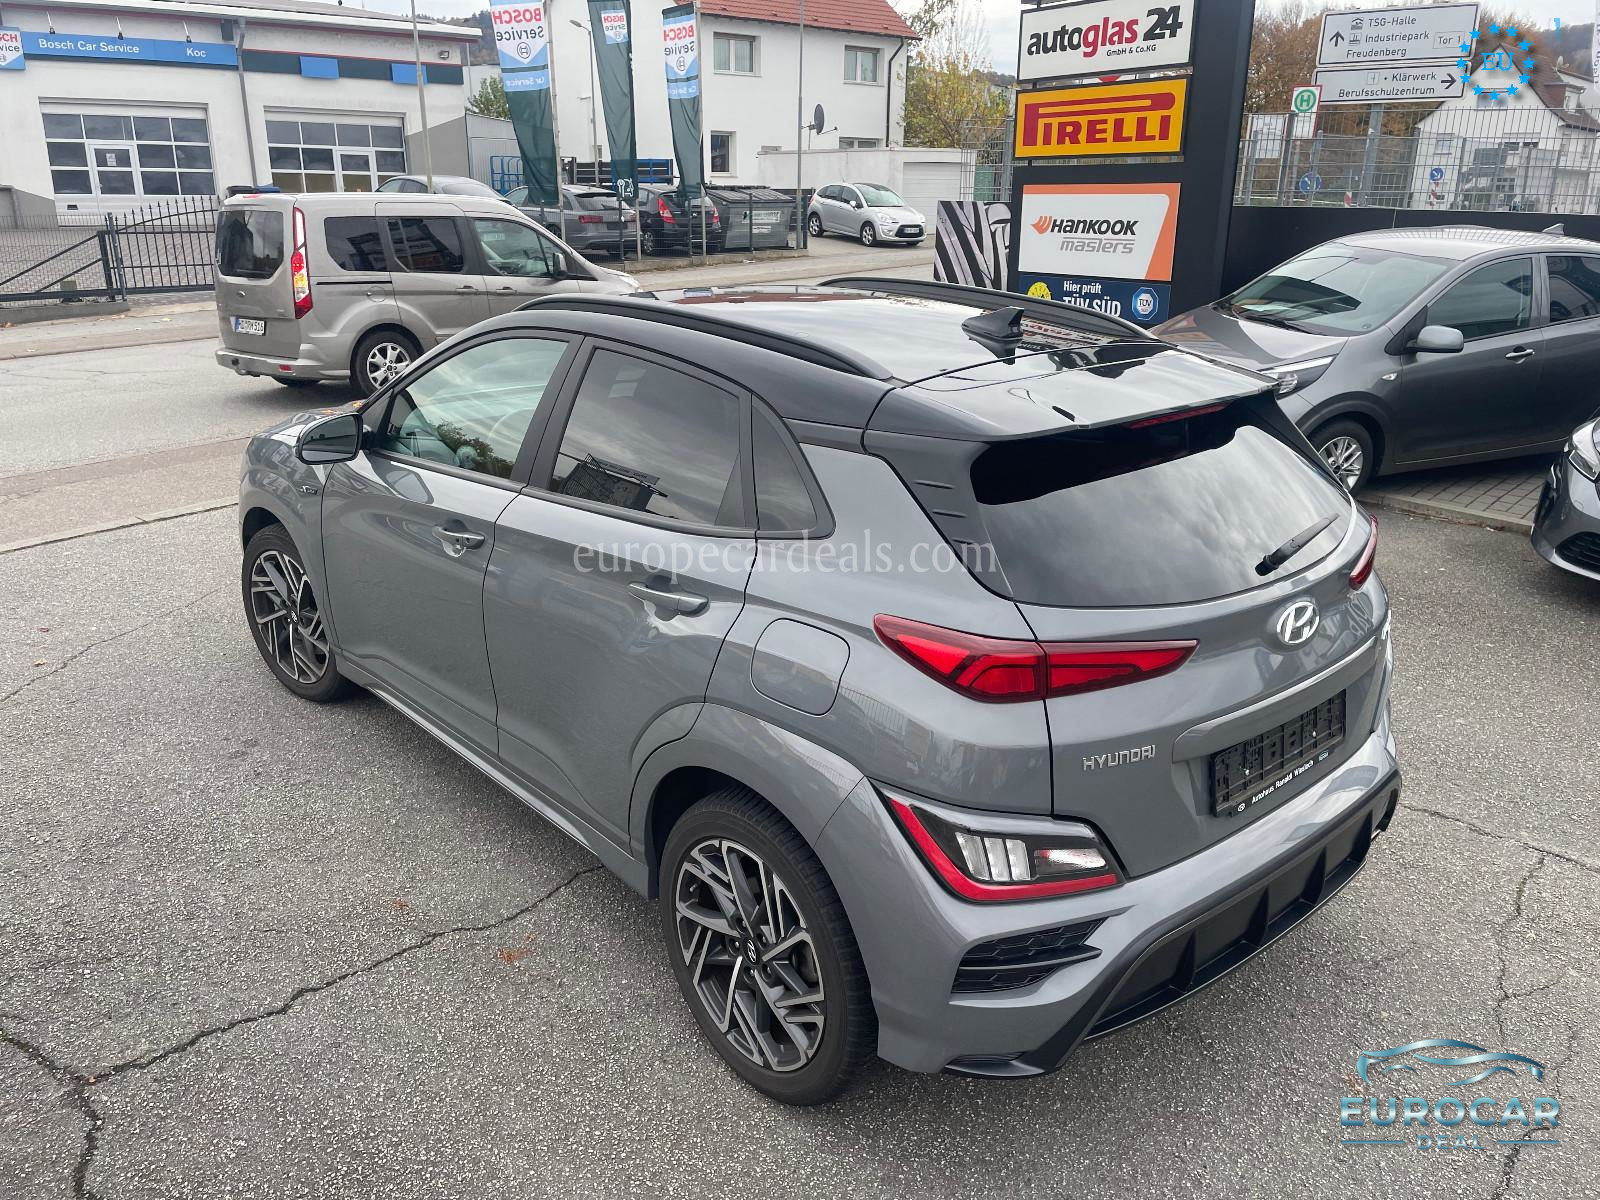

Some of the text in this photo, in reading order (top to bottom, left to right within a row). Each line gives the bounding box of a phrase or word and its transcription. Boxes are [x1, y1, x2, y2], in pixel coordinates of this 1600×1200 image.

[1368, 15, 1417, 28] TSG-Halle
[1027, 5, 1184, 58] autoglas 24
[1365, 31, 1430, 44] Industriepark
[39, 39, 140, 53] Bosch Car Service
[1437, 35, 1462, 45] Tor 1
[186, 47, 207, 58] Koc
[1106, 47, 1127, 57] GmbH
[1346, 47, 1407, 59] Freudenberg
[1391, 71, 1437, 82] Klärwerk
[1338, 85, 1435, 98] Berufsschulzentrum
[1022, 92, 1176, 147] PIRELLI
[1060, 238, 1135, 254] masters
[1063, 281, 1081, 292] Hier
[1082, 282, 1102, 295] prüft
[1092, 296, 1121, 317] SÜD
[1082, 744, 1156, 771] HYUNDAI
